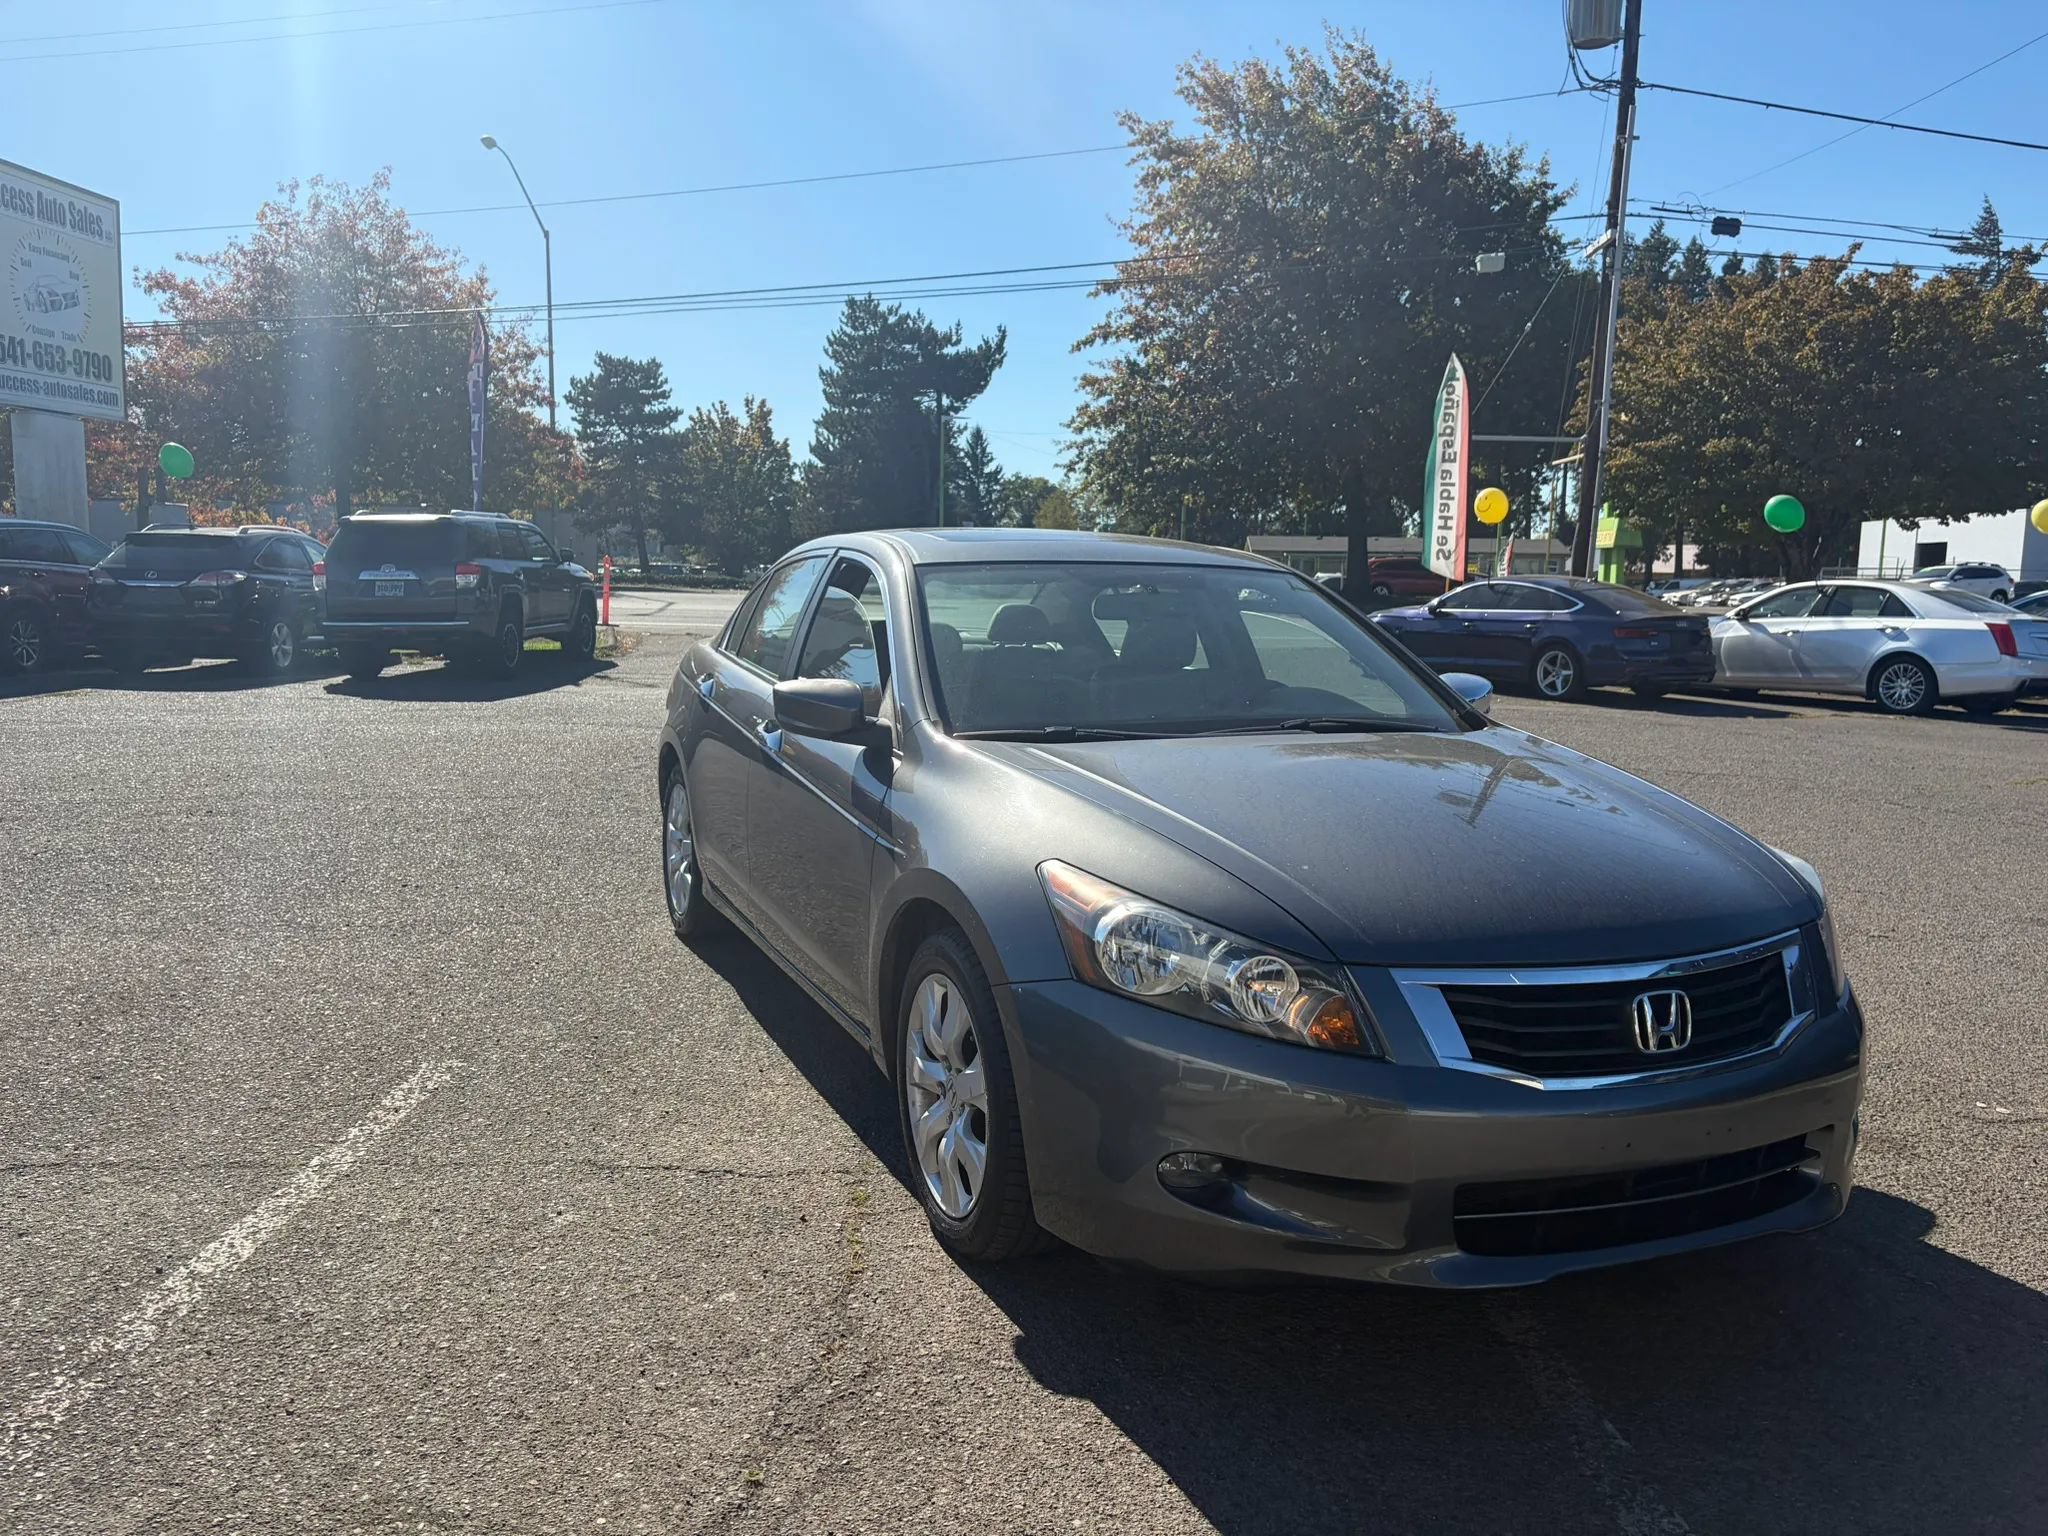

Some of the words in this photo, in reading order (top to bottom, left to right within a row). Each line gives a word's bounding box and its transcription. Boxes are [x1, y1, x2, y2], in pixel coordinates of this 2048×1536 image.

[0, 183, 34, 217] cess
[36, 191, 66, 226] Auto
[68, 201, 104, 240] Sales
[0, 334, 112, 383] 541-653-9790
